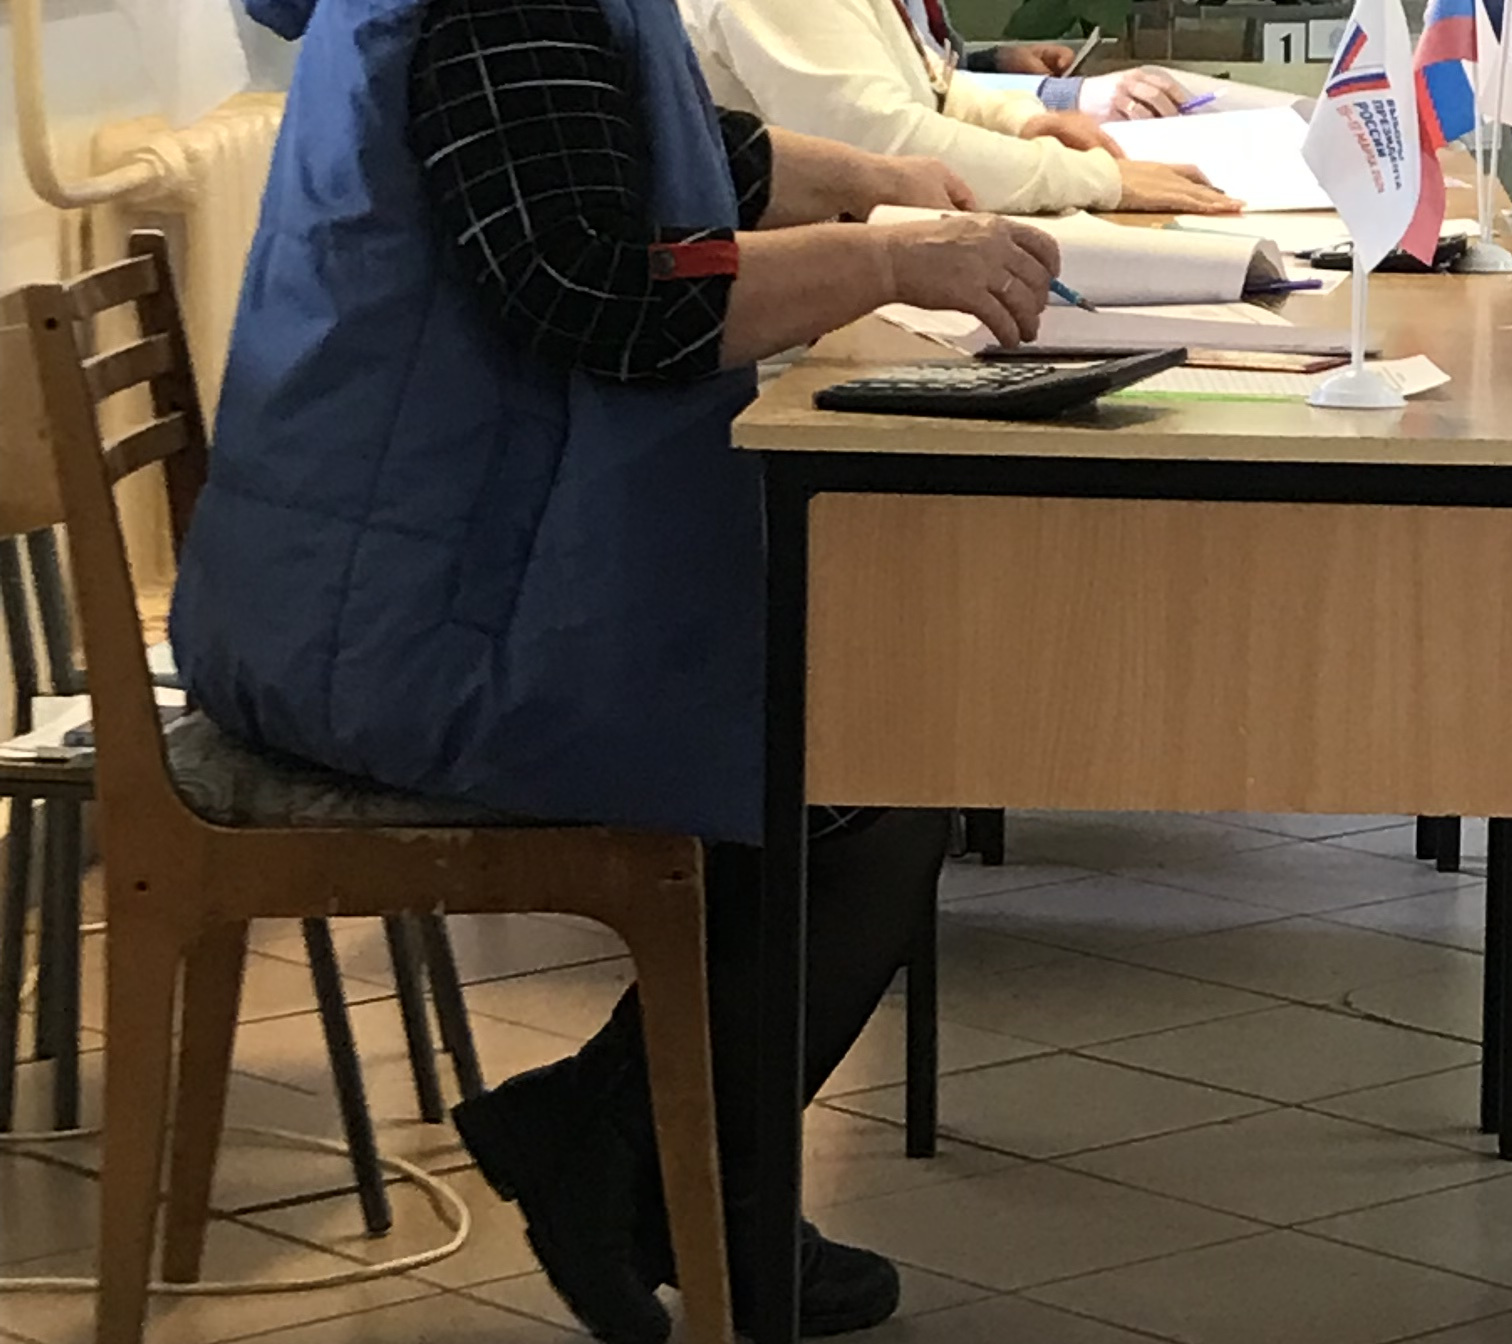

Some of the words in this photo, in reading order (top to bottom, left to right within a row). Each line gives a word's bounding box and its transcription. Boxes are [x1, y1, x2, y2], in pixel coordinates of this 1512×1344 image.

[1279, 32, 1292, 64] 1
[1352, 101, 1387, 157] РОССИИ
[1371, 99, 1402, 190] ПРЕЗИДЕНТА
[1386, 99, 1404, 161] ВЫБОРЫ
